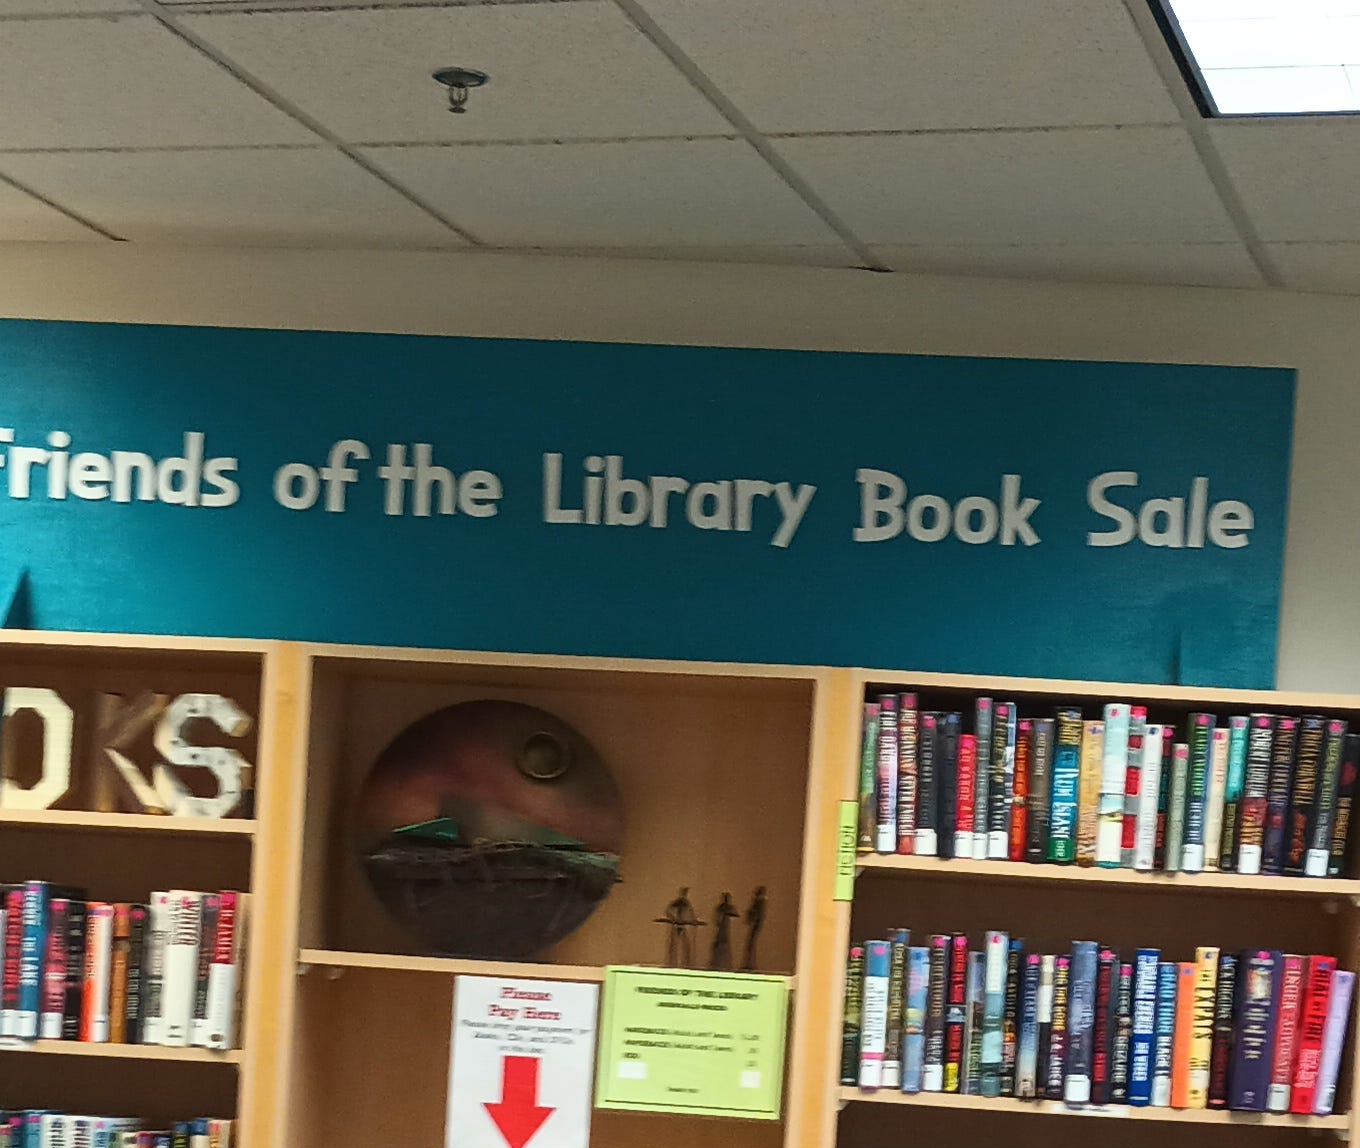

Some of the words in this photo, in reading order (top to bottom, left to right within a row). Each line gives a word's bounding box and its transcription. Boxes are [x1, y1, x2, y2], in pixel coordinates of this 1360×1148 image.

[273, 439, 370, 515] of
[377, 443, 500, 521] the
[541, 451, 817, 550] Library
[853, 466, 1043, 547] Book
[1086, 471, 1257, 550] Sale
[838, 825, 856, 876] FICTION
